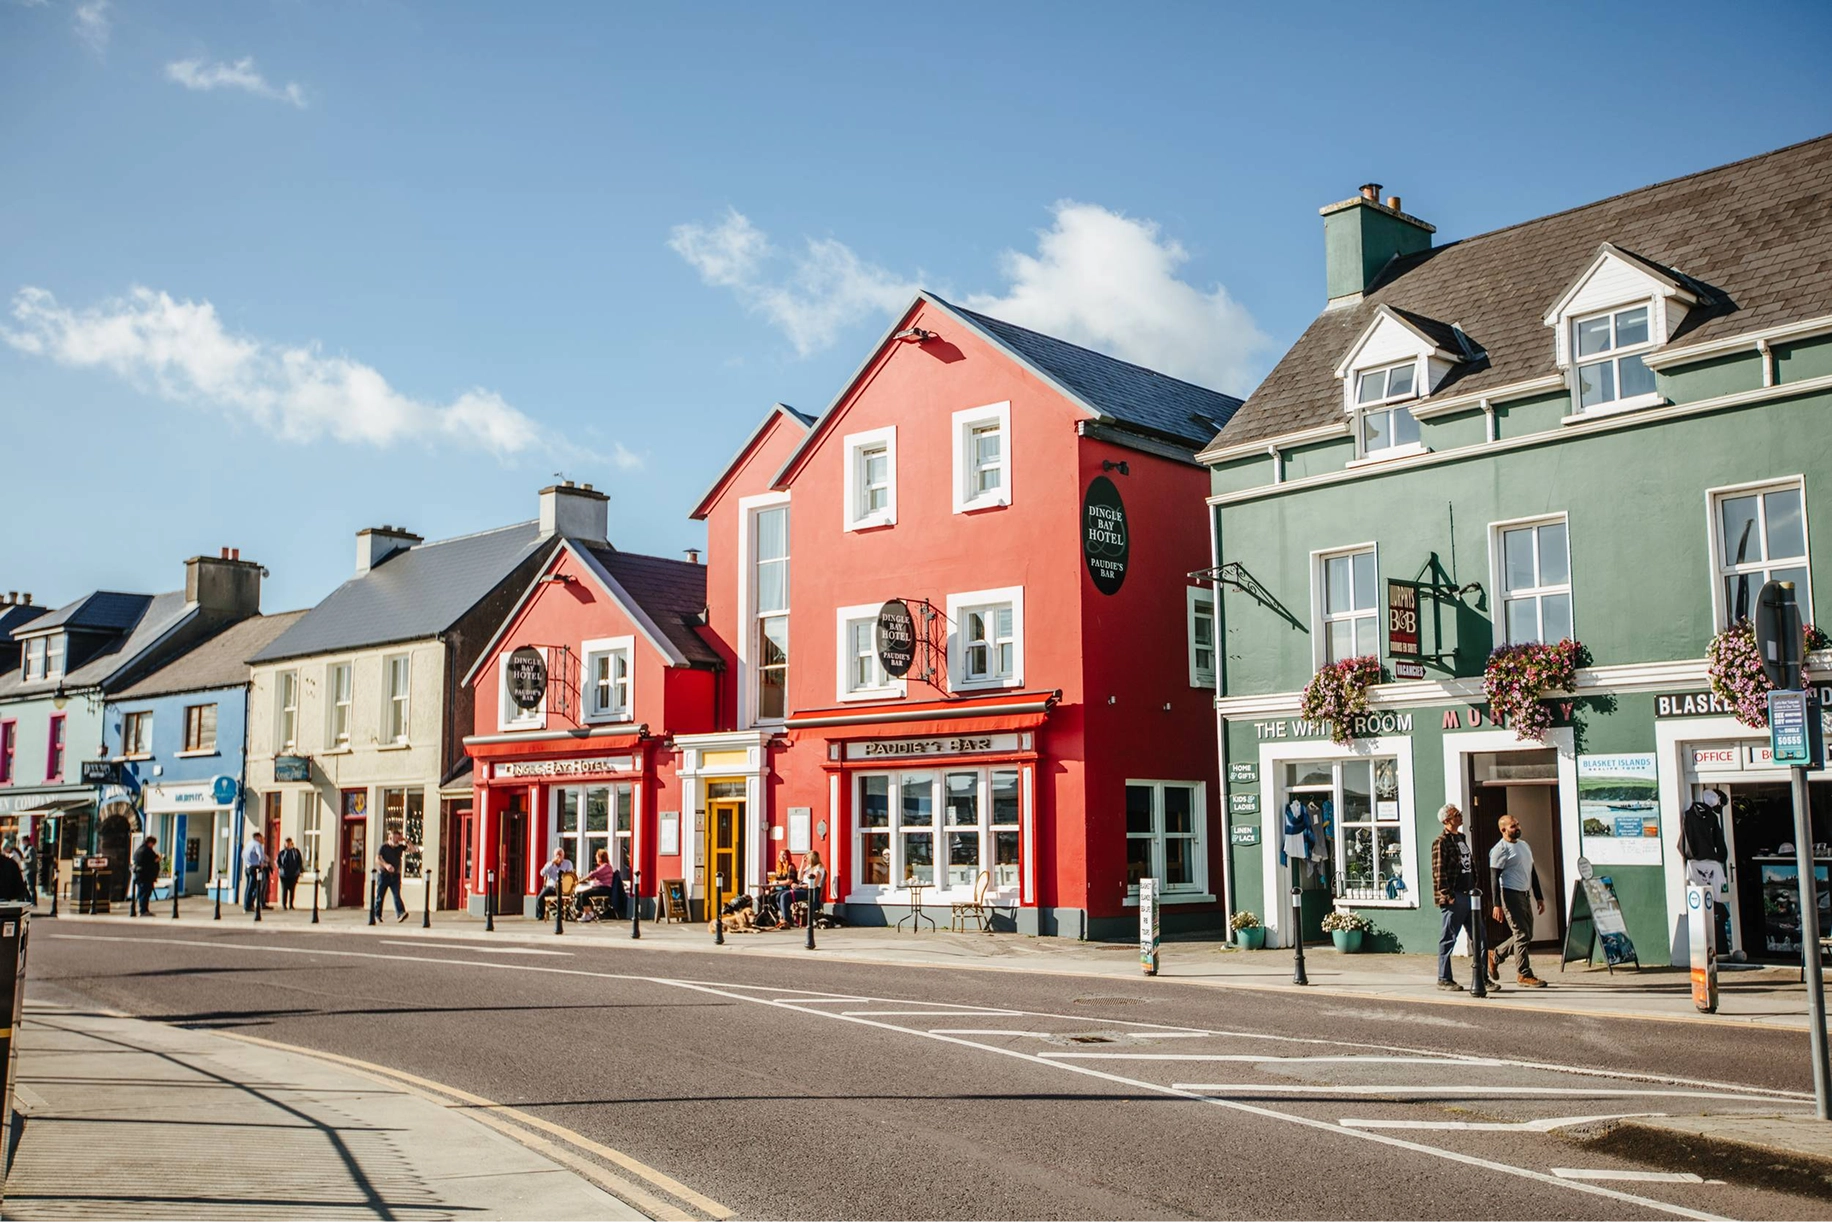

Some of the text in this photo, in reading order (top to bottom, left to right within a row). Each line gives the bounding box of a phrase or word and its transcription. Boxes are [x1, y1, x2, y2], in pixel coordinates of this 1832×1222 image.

[1089, 505, 1123, 522] DINGLE
[1097, 518, 1115, 531] BAY
[1088, 528, 1124, 545] HOTEL
[1090, 558, 1124, 571] PAUDIE'S
[1100, 569, 1115, 579] BAR
[882, 613, 910, 624] DINGLE
[1390, 608, 1416, 633] B&B
[889, 623, 903, 631] BAY
[882, 631, 910, 642] HOTEL
[514, 657, 541, 666] DINGLE
[883, 652, 910, 661] PAUDIE'S
[890, 659, 903, 667] BAR
[513, 671, 542, 680] HOTEL
[1396, 664, 1423, 677] VACANCIES
[1659, 693, 1735, 715] BLASKE
[1442, 703, 1573, 729] MURY
[1254, 714, 1413, 739] THE WHIT ROOM
[1778, 736, 1801, 745] 50555
[865, 739, 991, 755] PAUDIE'S BAR
[1694, 751, 1733, 763] OFFICE
[505, 760, 609, 776] DINGLE BAY HOTEL
[1230, 772, 1237, 780] &
[1232, 834, 1239, 842] &
